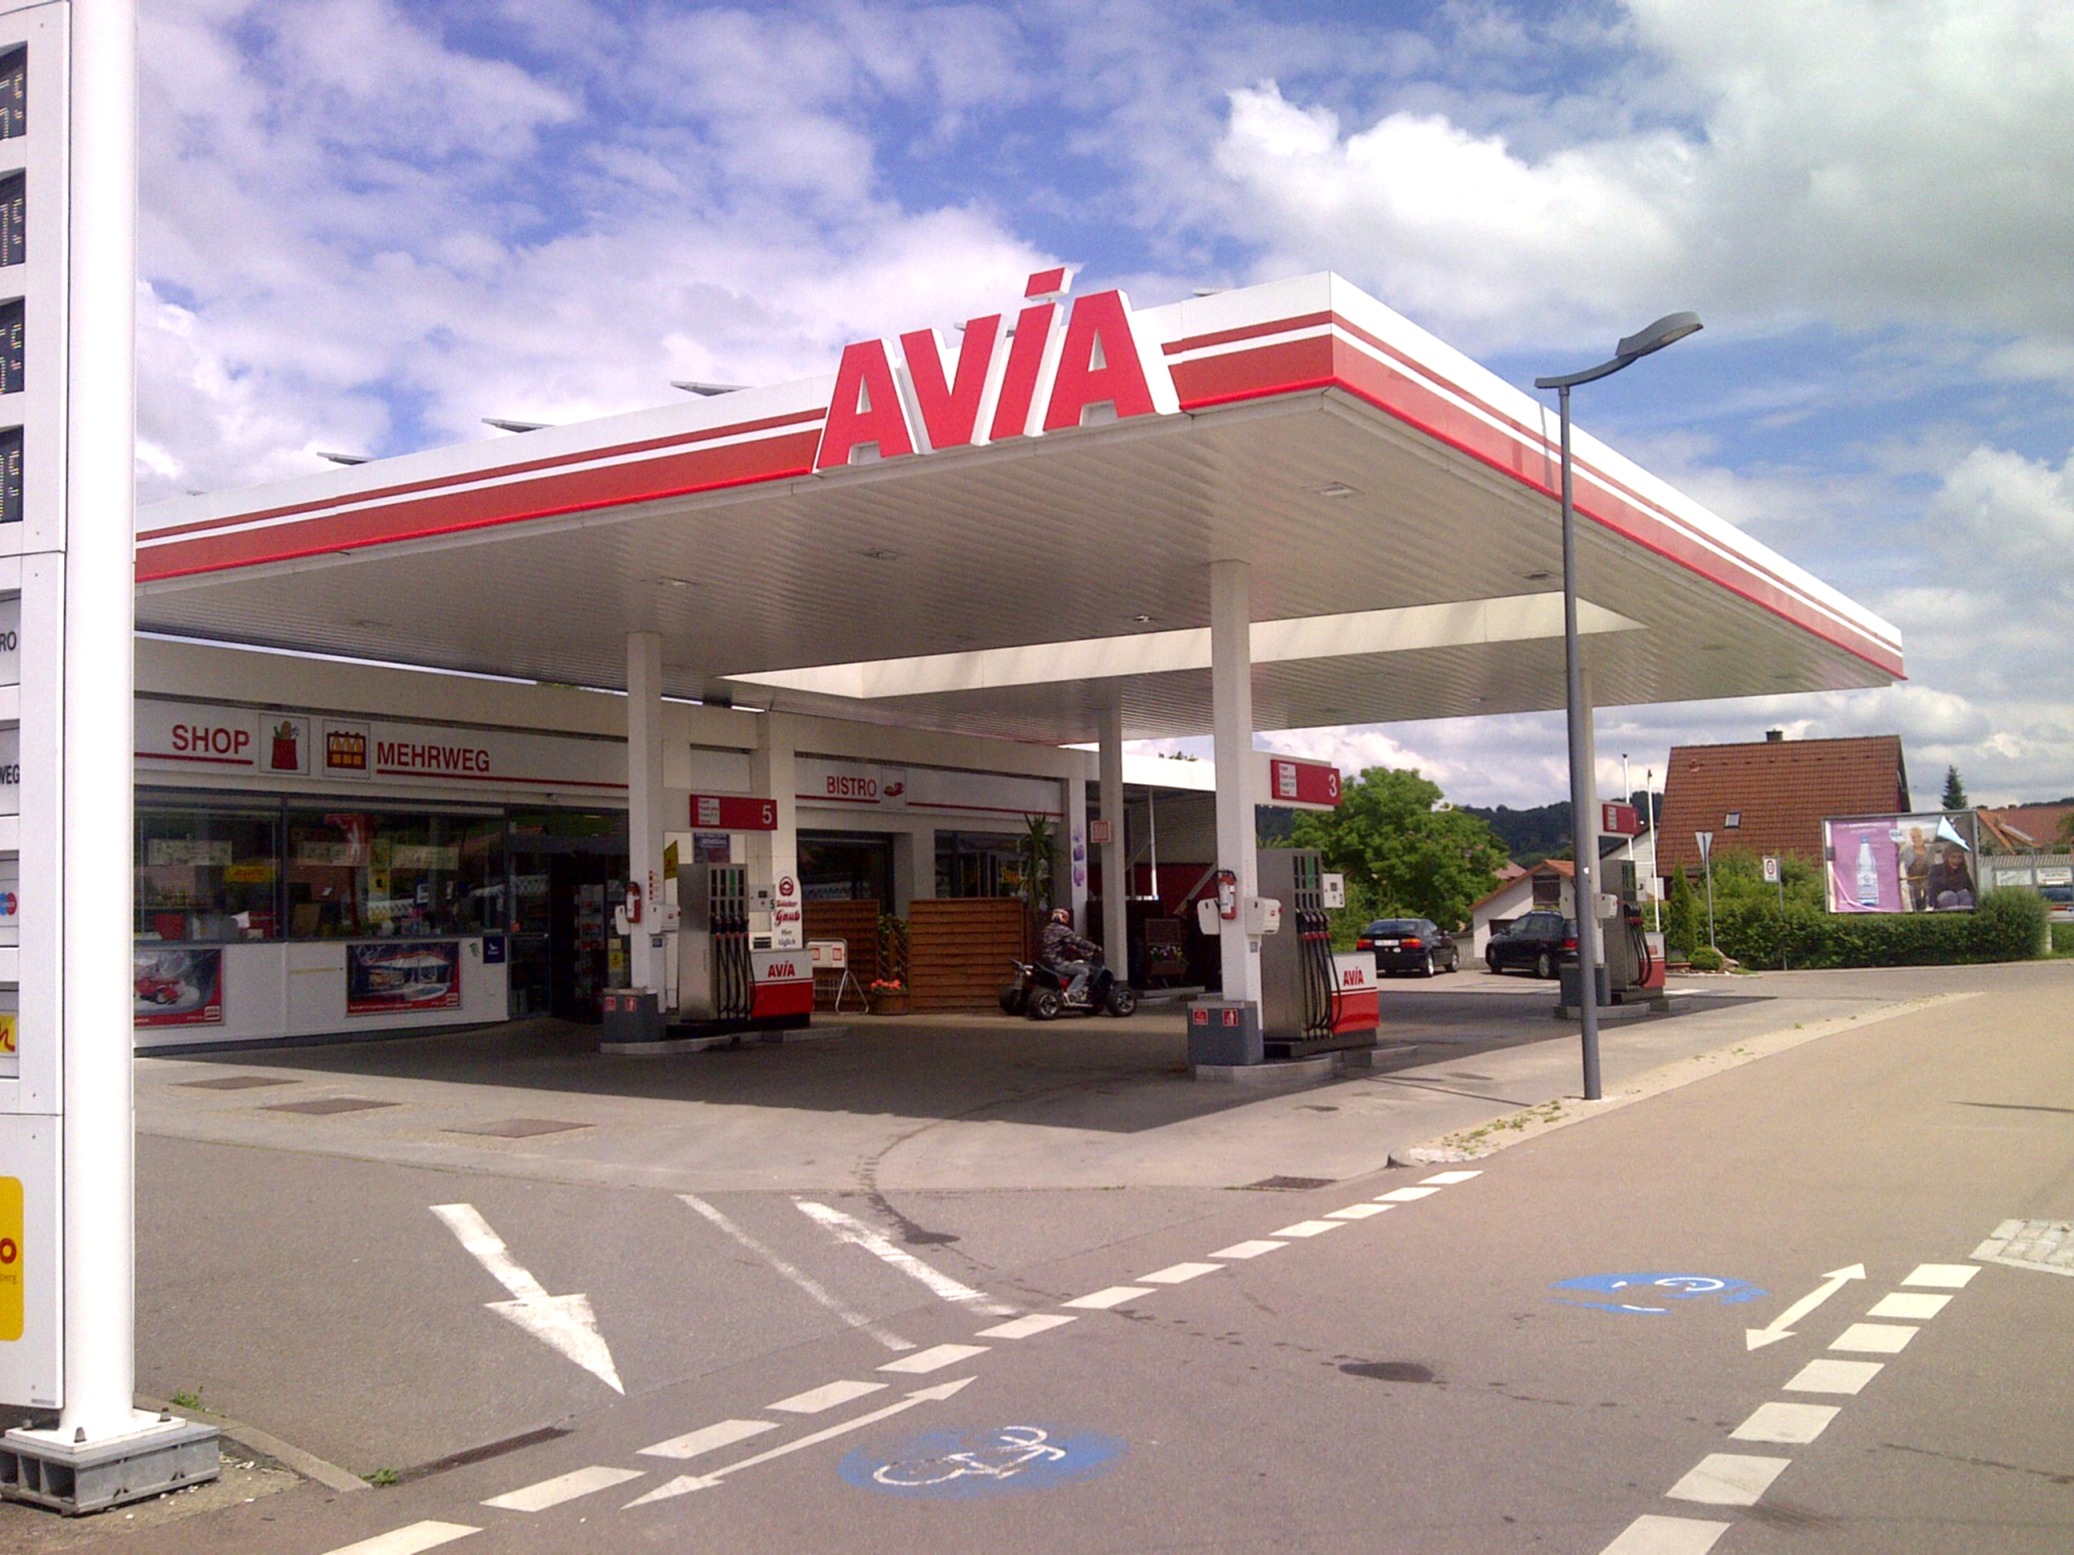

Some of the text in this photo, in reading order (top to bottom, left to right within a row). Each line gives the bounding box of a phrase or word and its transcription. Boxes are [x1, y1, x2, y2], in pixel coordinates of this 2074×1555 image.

[172, 724, 250, 754] SHOP
[377, 741, 490, 772] MEHRWEG
[827, 776, 877, 797] BISTRO
[1328, 774, 1338, 797] 3
[762, 804, 773, 824] 5
